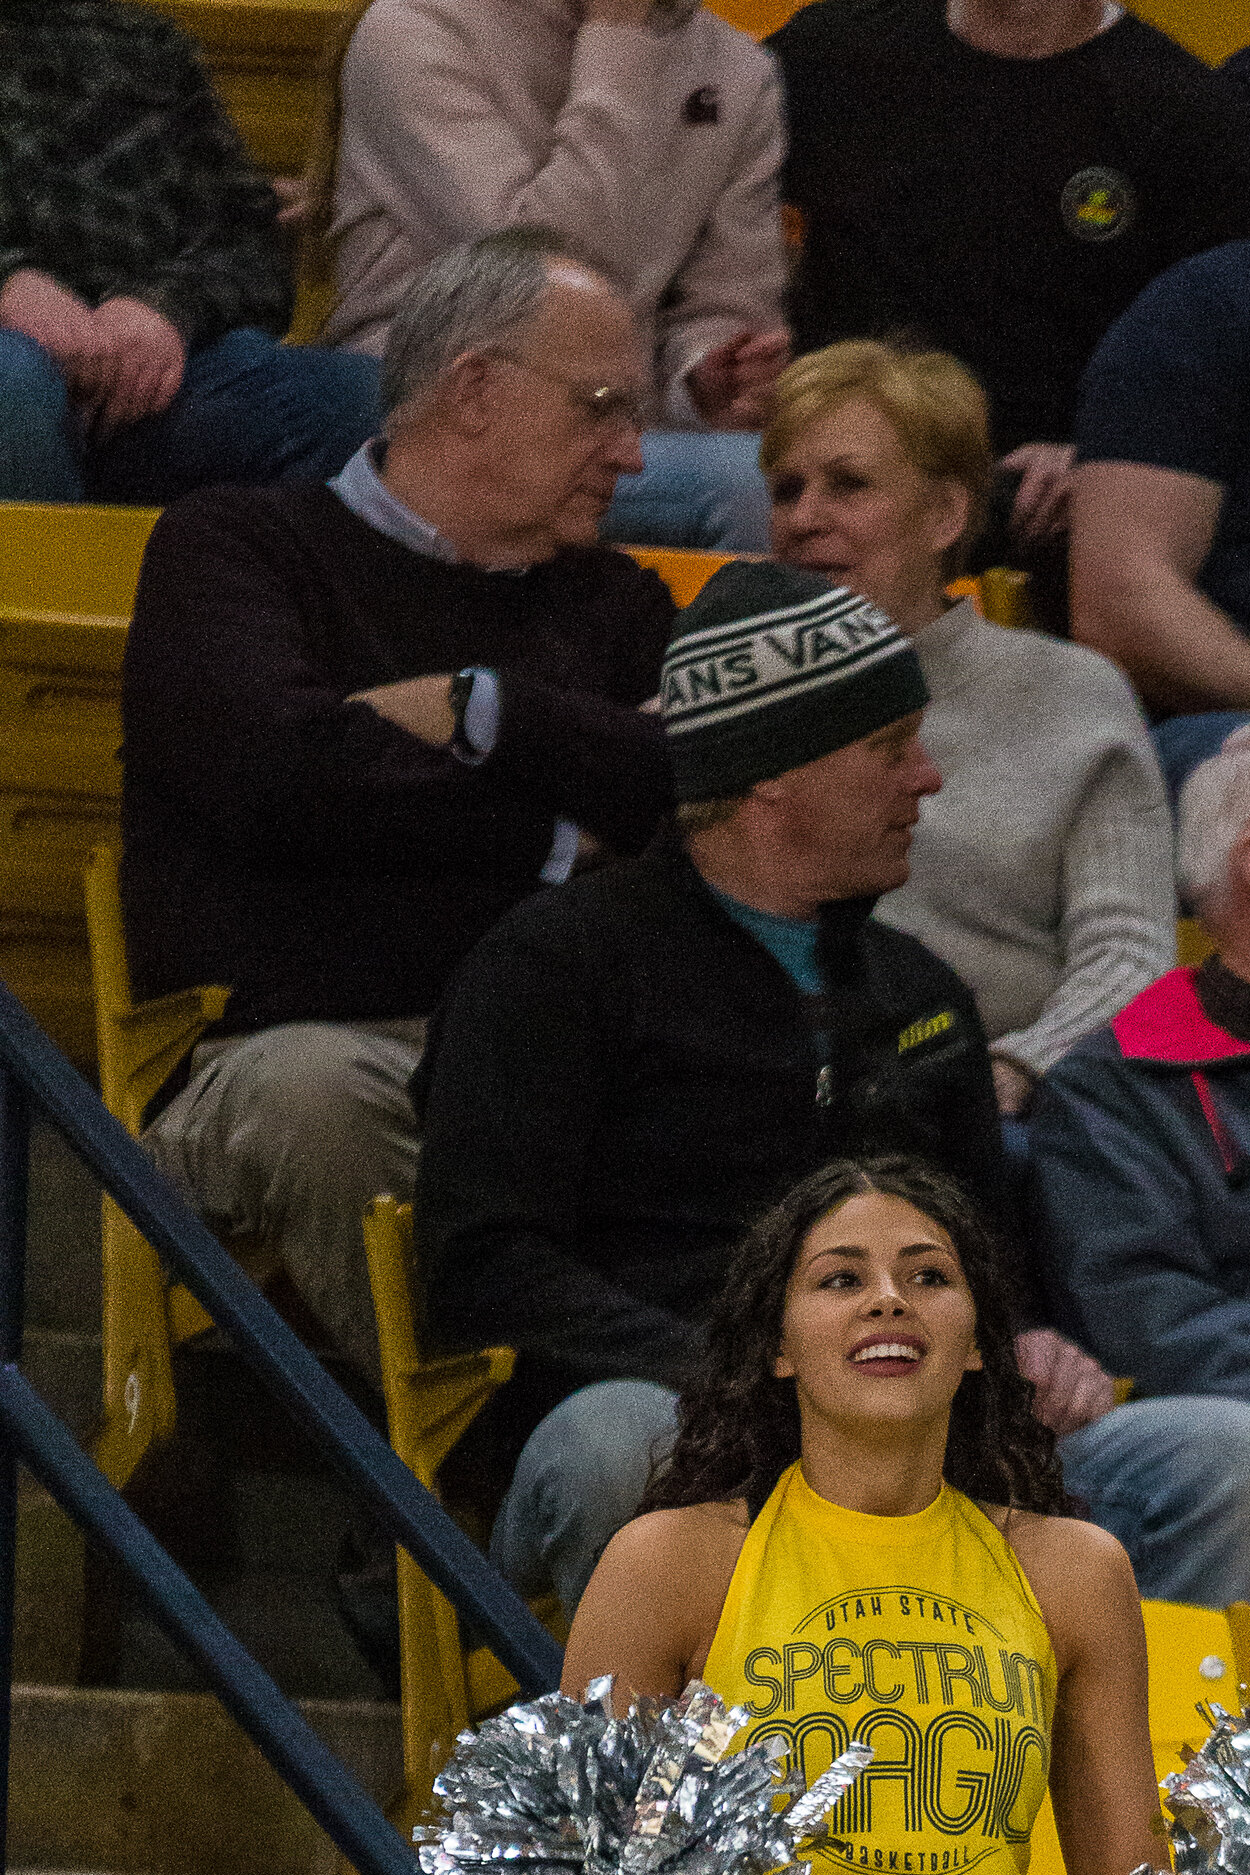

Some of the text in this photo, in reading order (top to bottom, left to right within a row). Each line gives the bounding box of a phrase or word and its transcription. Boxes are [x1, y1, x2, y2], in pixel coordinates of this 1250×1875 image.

[667, 640, 757, 704] ANS
[826, 1595, 976, 1636] UTAH STATE
[743, 1637, 1044, 1726] SPECTRUM
